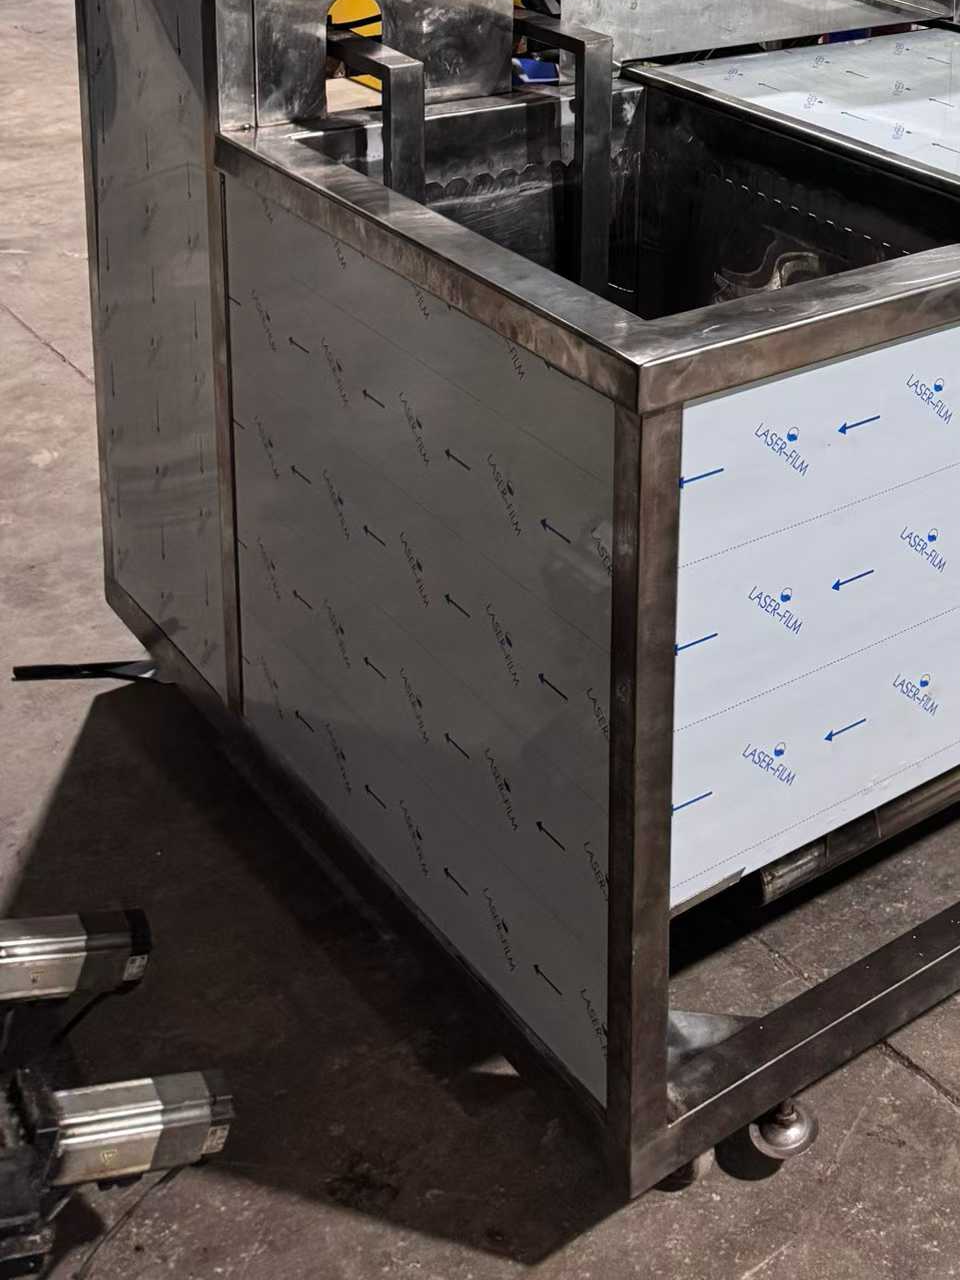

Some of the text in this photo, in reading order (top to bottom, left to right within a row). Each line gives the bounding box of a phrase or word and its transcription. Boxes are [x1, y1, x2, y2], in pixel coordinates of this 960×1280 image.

[906, 374, 952, 424] LASER-FILM
[755, 423, 809, 476] LASER-FILM
[487, 454, 522, 536] LASER-FILM
[900, 526, 946, 573] LASER-FILM
[748, 586, 803, 634] LASER-FILM
[486, 603, 519, 686] LASER-FILM
[893, 675, 938, 716] LASER-FILM
[484, 748, 518, 831] LASER-FILM
[742, 744, 796, 786] LASER-FILM
